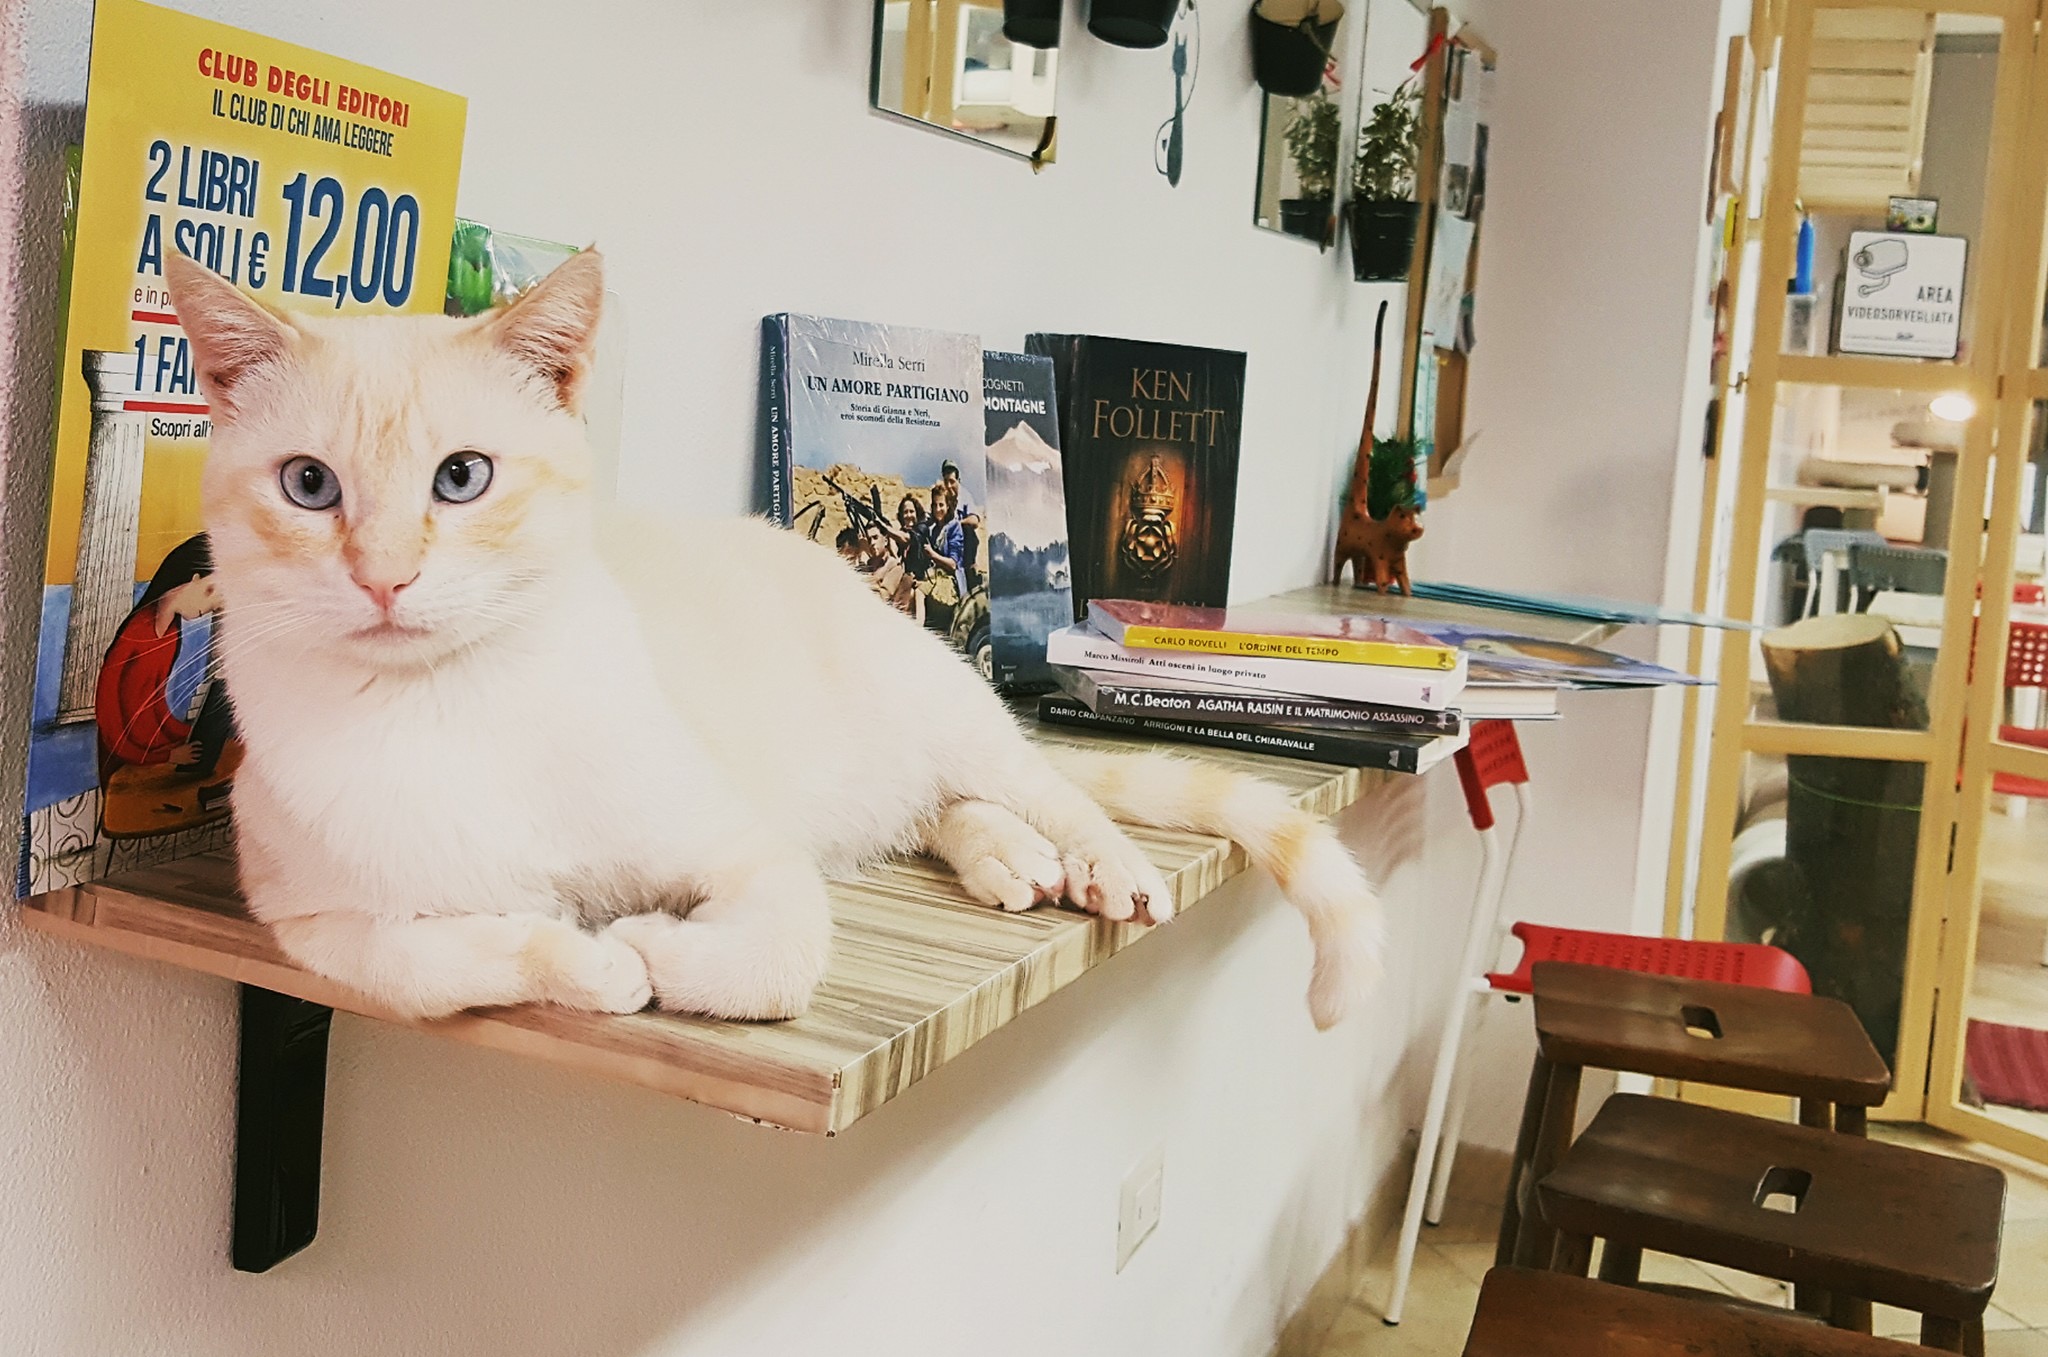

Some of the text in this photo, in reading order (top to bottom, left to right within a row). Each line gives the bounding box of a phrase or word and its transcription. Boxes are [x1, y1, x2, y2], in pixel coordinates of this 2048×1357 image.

[198, 48, 410, 128] CLUB DEGLI EDITORI
[212, 89, 394, 157] IL CLUB DI CHI AMA LEGGERE
[145, 140, 260, 218] 2 LIBRI
[137, 214, 162, 276] A
[248, 231, 270, 290] €
[282, 172, 419, 310] 12,00
[134, 287, 143, 303] e
[146, 285, 158, 304] in
[1917, 286, 1953, 303] AREA
[134, 334, 147, 392] 1
[852, 351, 926, 372] Mirella Serri
[807, 375, 969, 404] UN AMORE PARTIGIANO
[1131, 367, 1192, 402] KEN
[770, 406, 779, 423] UN
[850, 403, 872, 413] Storia
[873, 404, 881, 413] di
[882, 405, 906, 416] Gianna
[983, 396, 1046, 415] MONTAGNE
[151, 418, 192, 440] Scopri
[840, 412, 941, 427] eroi scomodi della Resistenza
[1092, 399, 1225, 447] FOLLETT
[771, 424, 781, 468] AMORE
[1154, 636, 1227, 649] CARLO ROVELLI
[1239, 642, 1339, 657] L'ORDINE DEL TEMPO
[1084, 650, 1145, 665] Marco Missiroli
[1148, 658, 1266, 680] Atti osceni in luogo privato
[1050, 706, 1135, 725] DARIO CRAPANZANO
[1196, 698, 1425, 724] AGATHA RAISIN E IL MATRIMONIO ASSASSINO
[1143, 719, 1315, 751] ARRIGONI E LA BELLA DEL CHIARAVALLE
